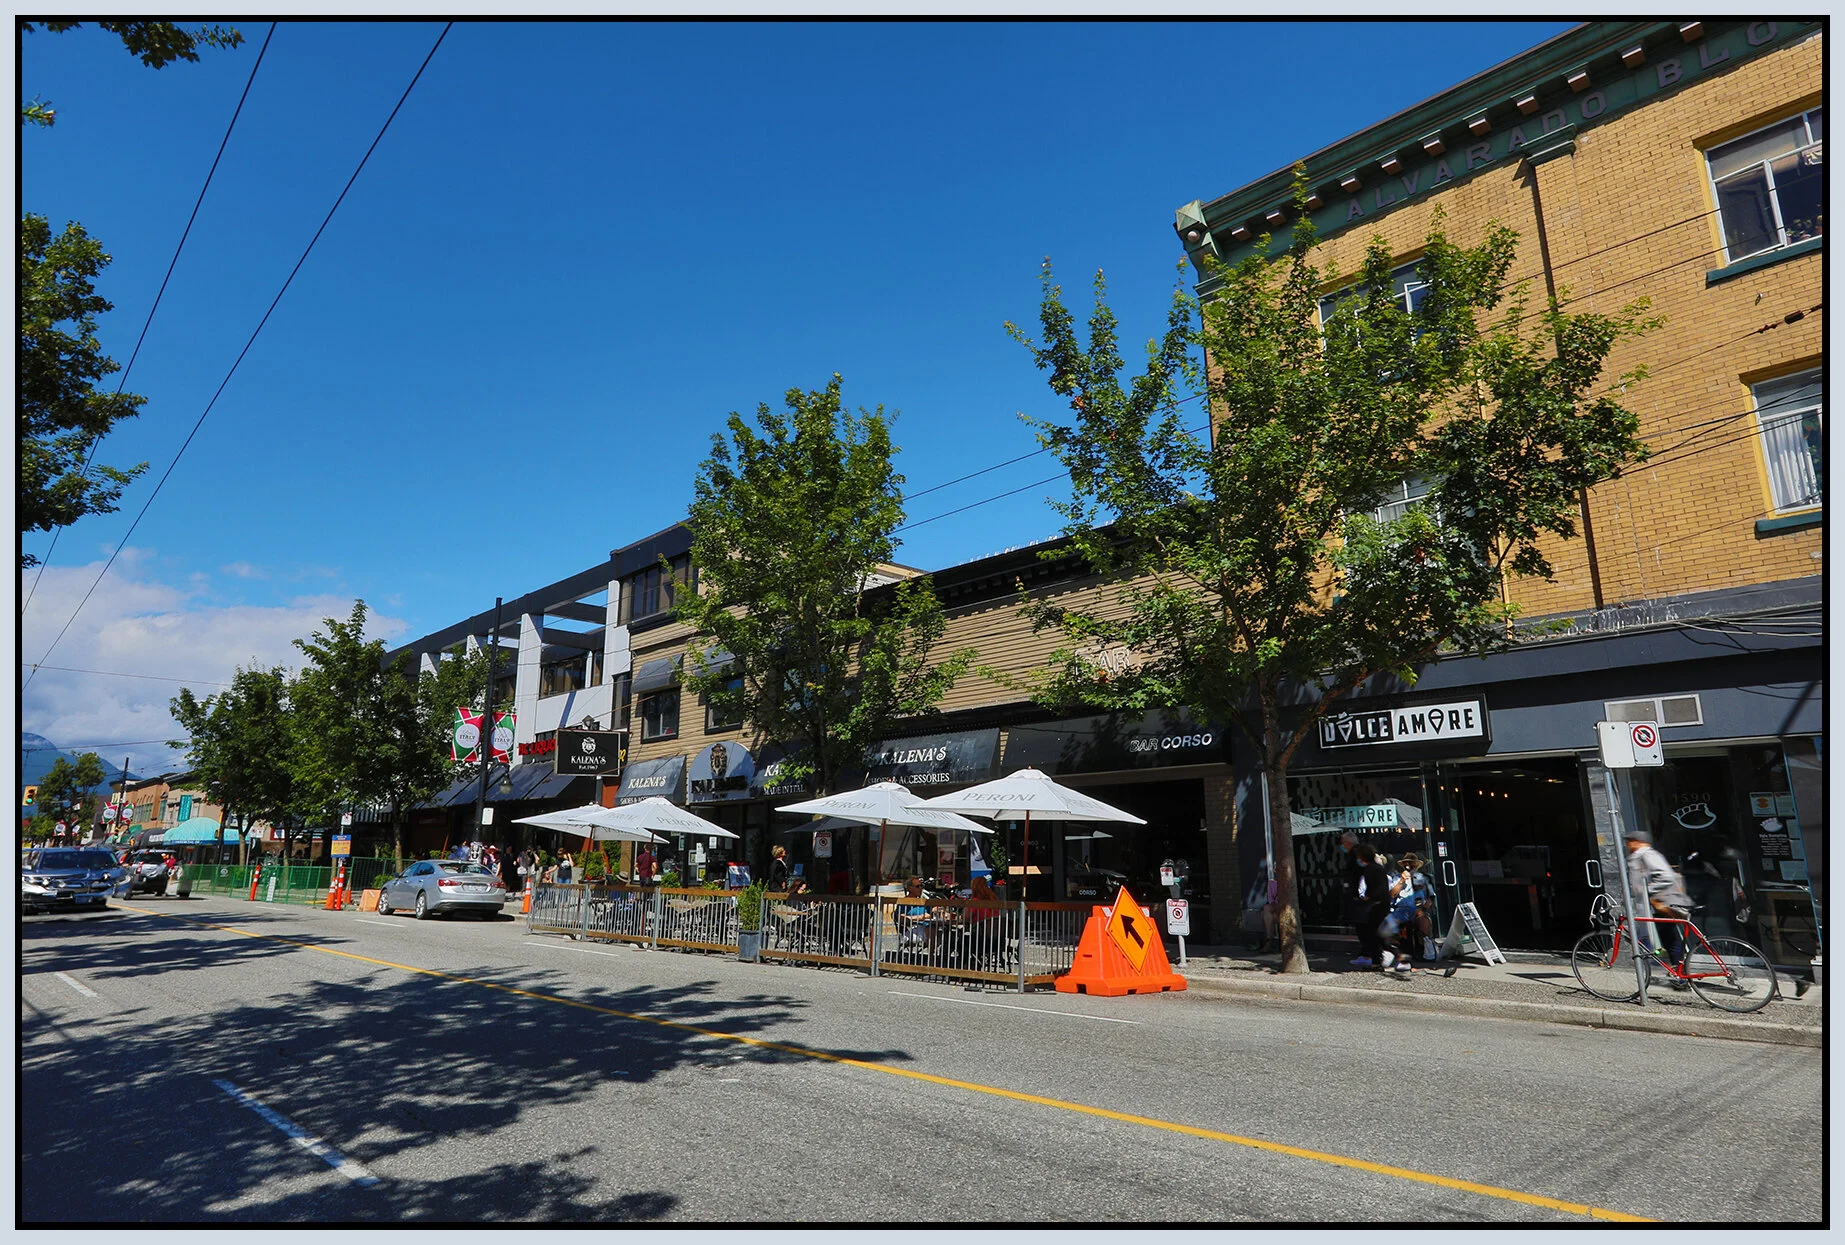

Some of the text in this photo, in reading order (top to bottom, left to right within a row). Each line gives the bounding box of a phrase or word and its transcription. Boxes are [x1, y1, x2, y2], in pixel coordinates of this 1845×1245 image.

[1347, 22, 1814, 221] ALVARADO BLO
[1398, 708, 1475, 735] AMORE
[530, 738, 557, 756] LIQUO
[1129, 733, 1213, 752] BAR CORSO
[571, 755, 607, 765] KALENA'S
[881, 746, 947, 765] KALENA'S
[628, 775, 667, 789] KALENA'S
[900, 772, 950, 785] ACCESSORIES
[963, 792, 1036, 801] PERONI
[821, 800, 877, 810] PERONI
[656, 815, 703, 829] PERONI
